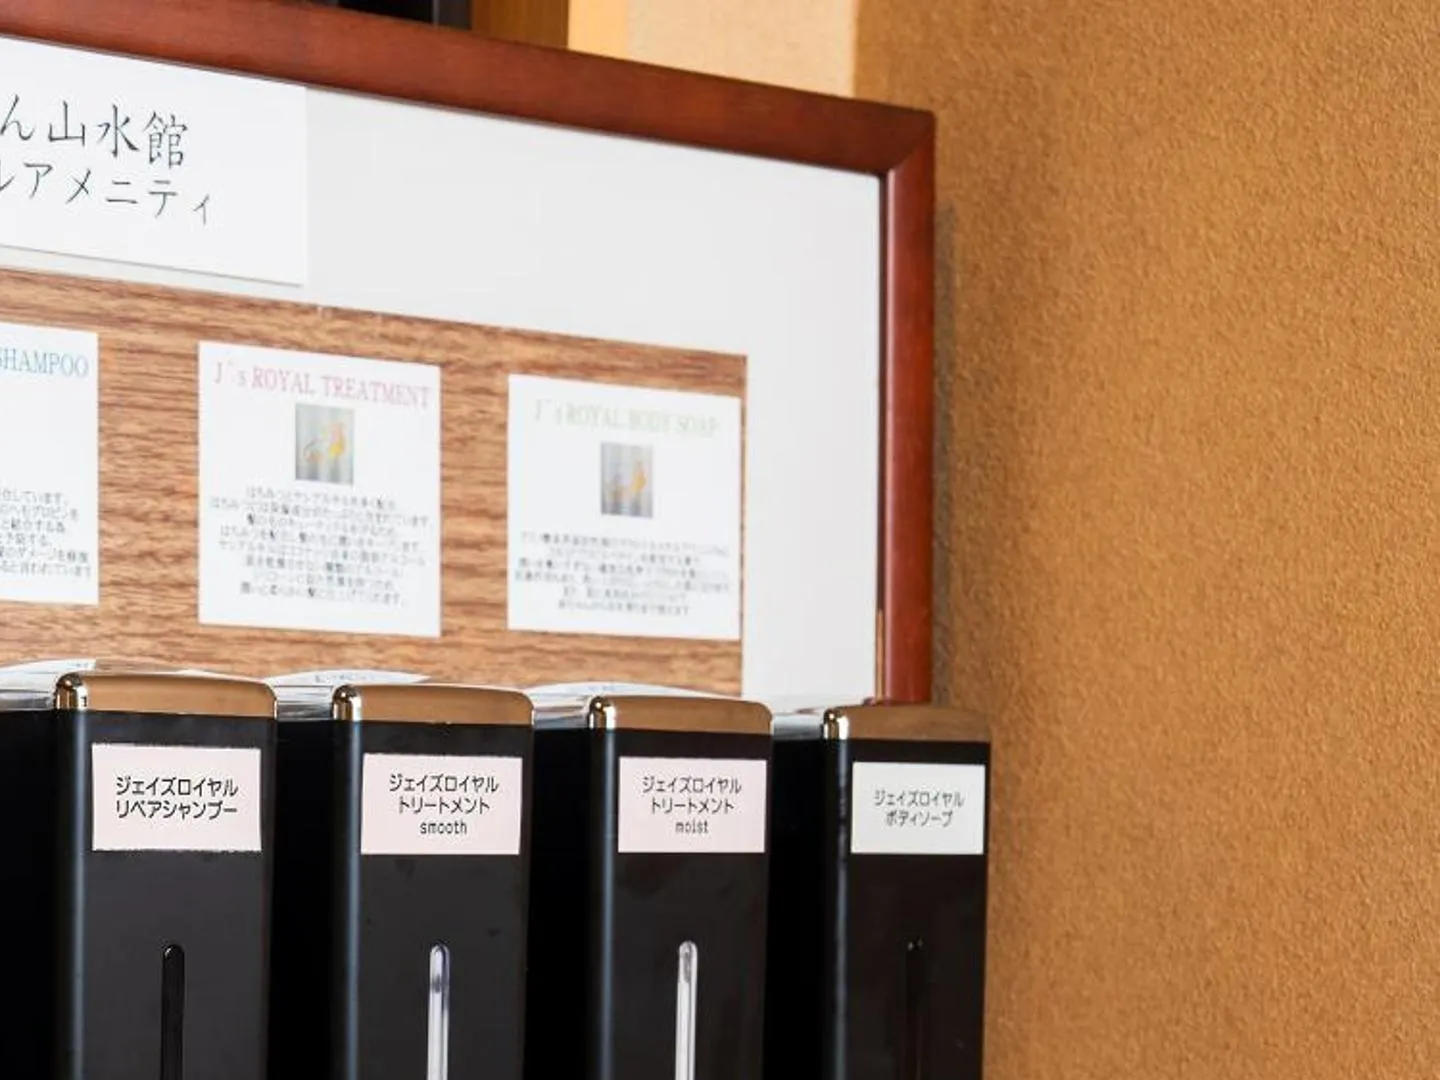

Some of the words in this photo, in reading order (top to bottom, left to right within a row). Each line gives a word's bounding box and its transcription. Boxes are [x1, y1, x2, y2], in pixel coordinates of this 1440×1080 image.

[252, 366, 316, 396] ROYAL
[320, 375, 430, 409] TREATMENT
[115, 776, 239, 798] ジェイズロイヤル
[389, 773, 500, 793] ジェイズロイヤル
[642, 775, 742, 794] ジェイズロイヤル
[398, 796, 491, 815] トリートメント
[651, 797, 735, 814] トリートメント
[873, 789, 966, 807] ジェイズロイヤル
[116, 799, 238, 821] リペアシャンプー
[885, 810, 954, 828] ボディソープ
[419, 818, 468, 835] smooth
[675, 819, 710, 834] moist
